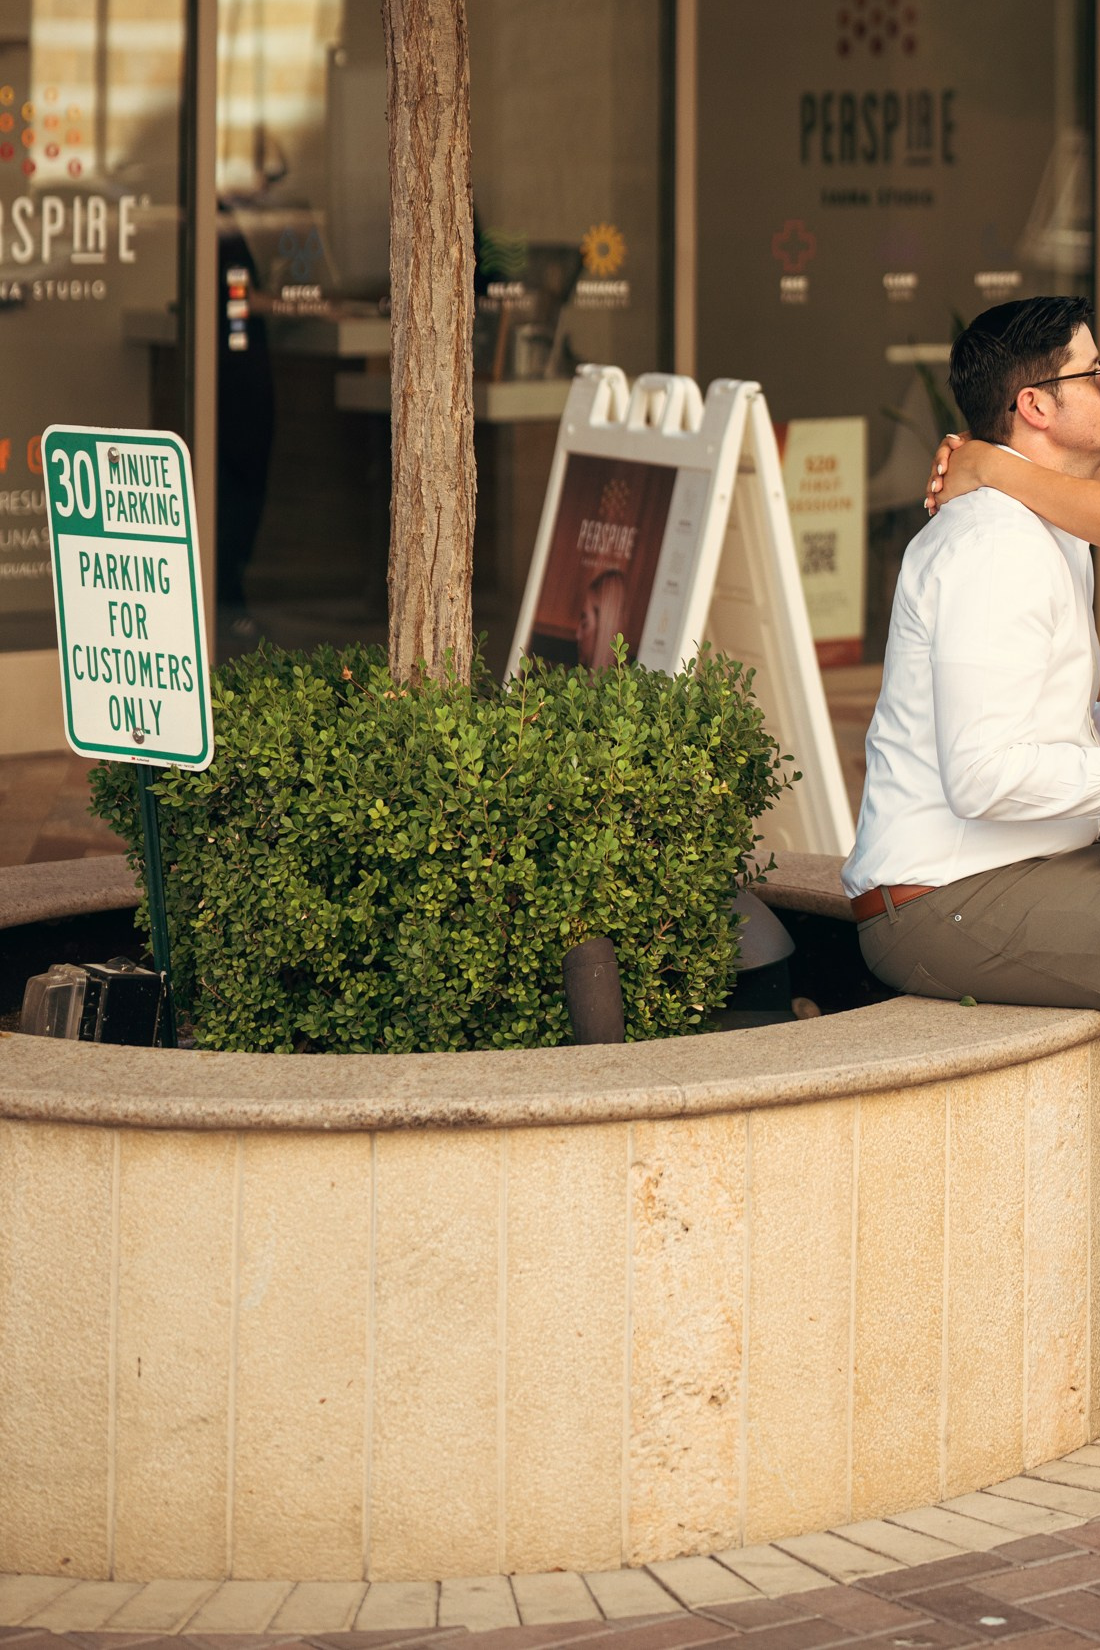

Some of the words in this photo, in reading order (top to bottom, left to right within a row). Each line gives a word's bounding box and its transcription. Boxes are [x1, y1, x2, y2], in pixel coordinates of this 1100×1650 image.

[800, 88, 956, 167] PERSPIRE
[32, 280, 107, 301] STUDIO
[51, 449, 97, 520] 30
[109, 452, 172, 489] MINUTE
[105, 489, 180, 527] PARKING
[577, 519, 637, 561] PERSPIRE
[79, 551, 170, 595] PARKING
[108, 601, 148, 640] FOR
[72, 644, 194, 692] CUSTOMERS
[109, 694, 162, 736] ONLY
